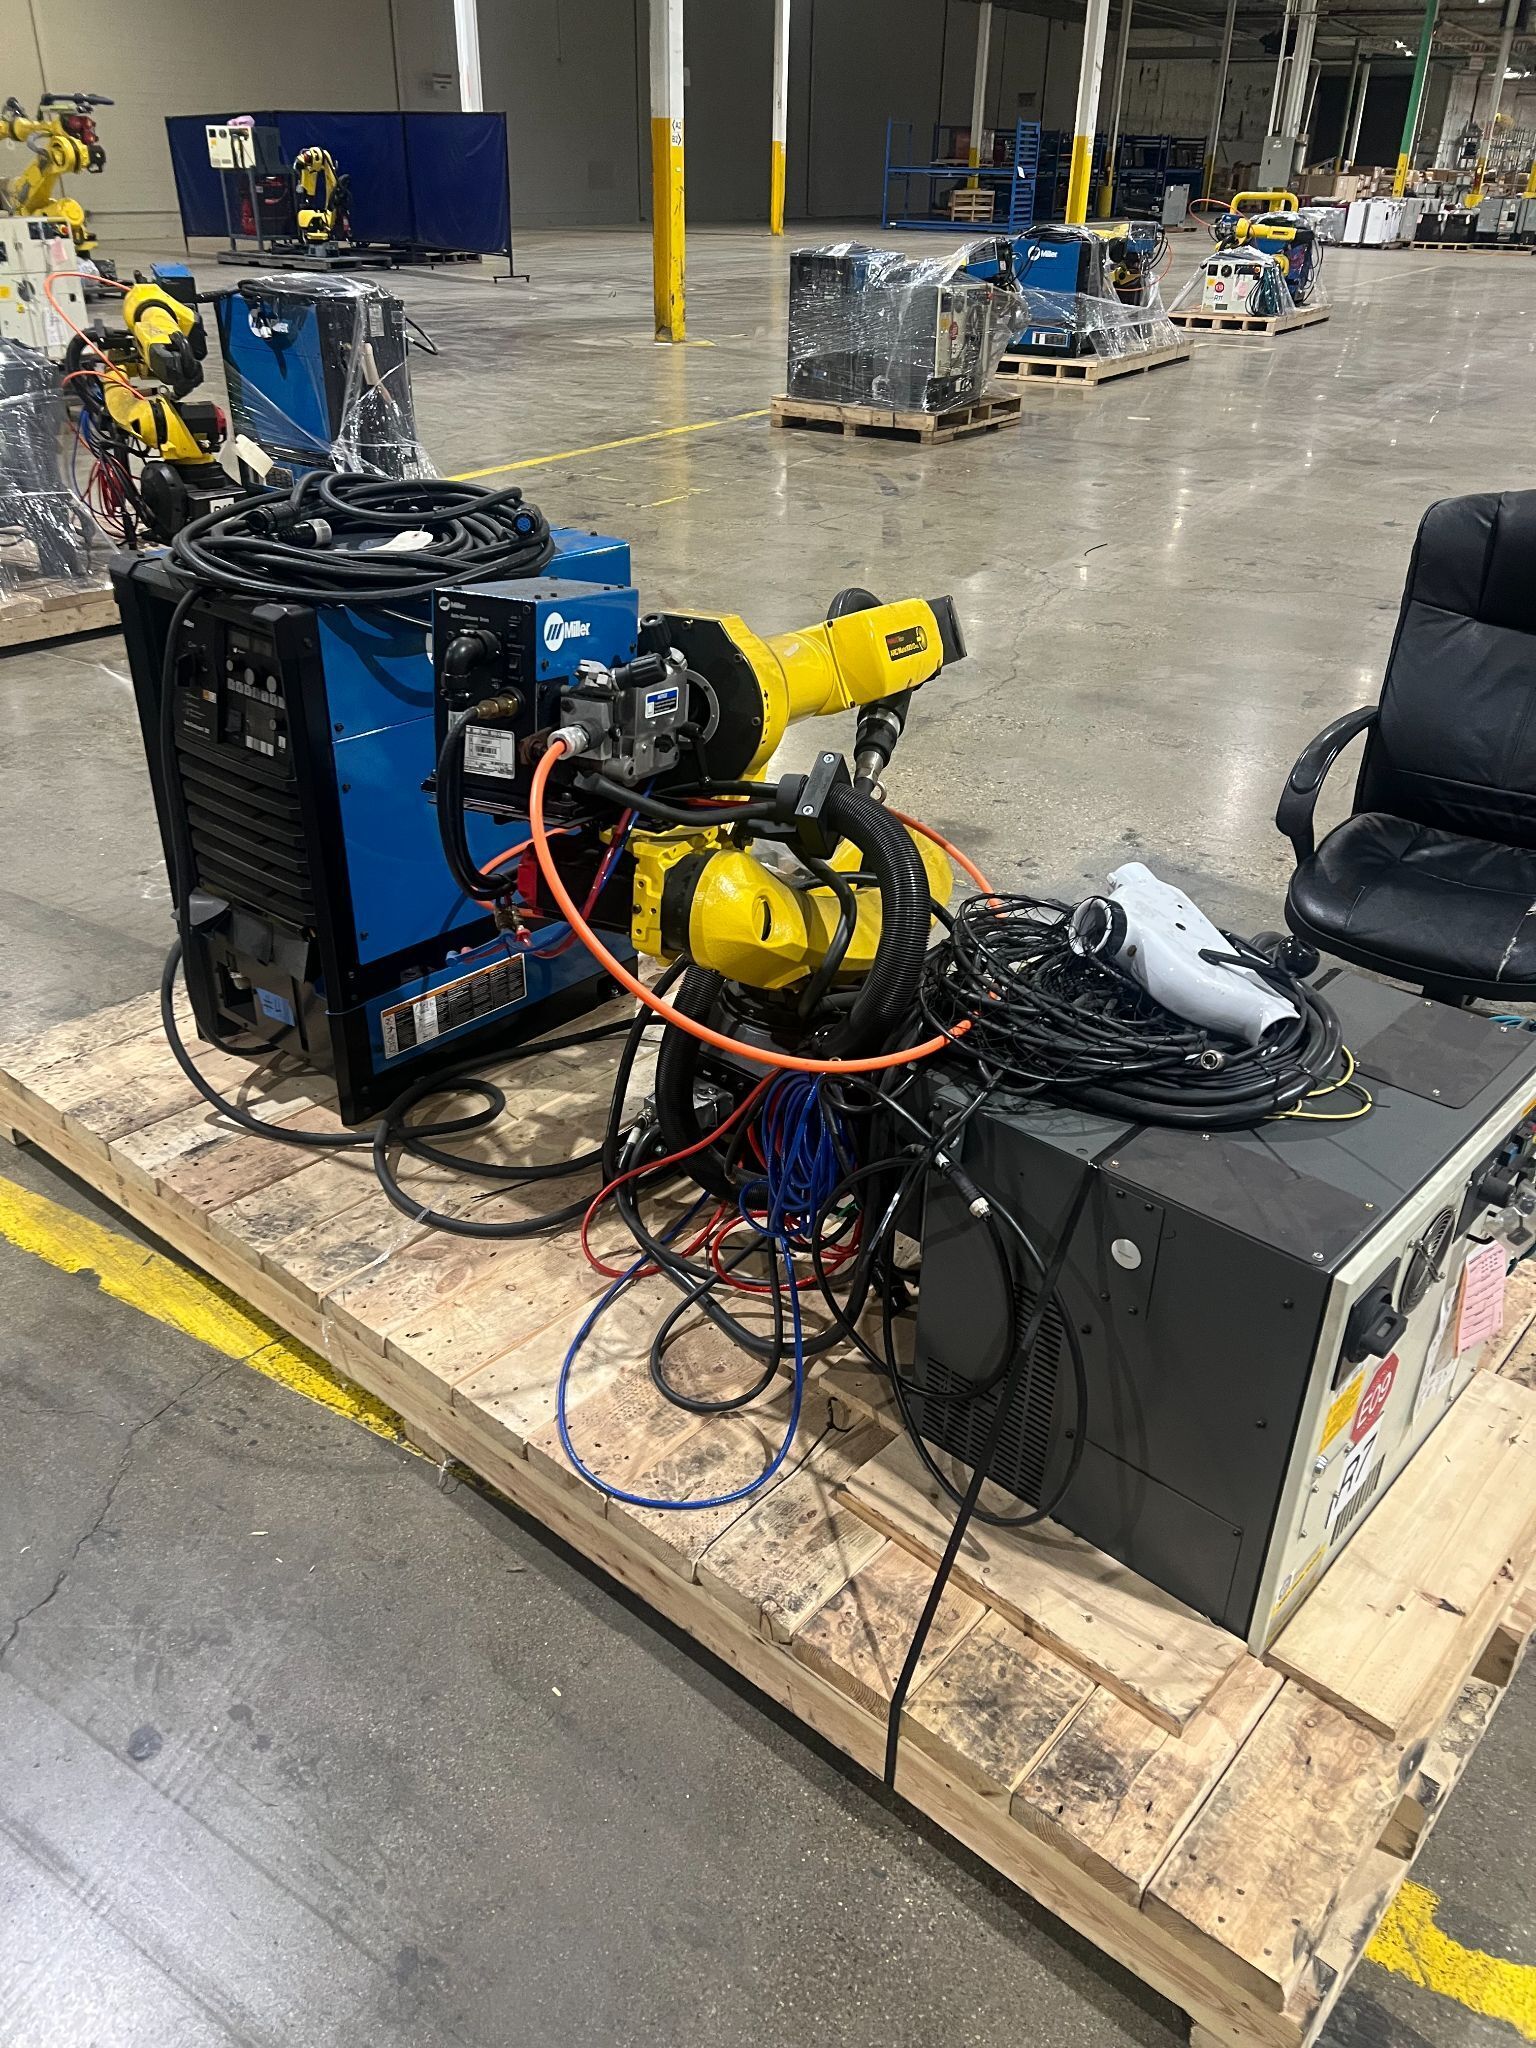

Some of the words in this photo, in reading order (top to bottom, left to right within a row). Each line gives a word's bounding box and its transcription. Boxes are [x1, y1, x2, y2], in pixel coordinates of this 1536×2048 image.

[1041, 250, 1058, 258] Miller
[564, 620, 591, 639] Miller
[1356, 1371, 1393, 1430] E09
